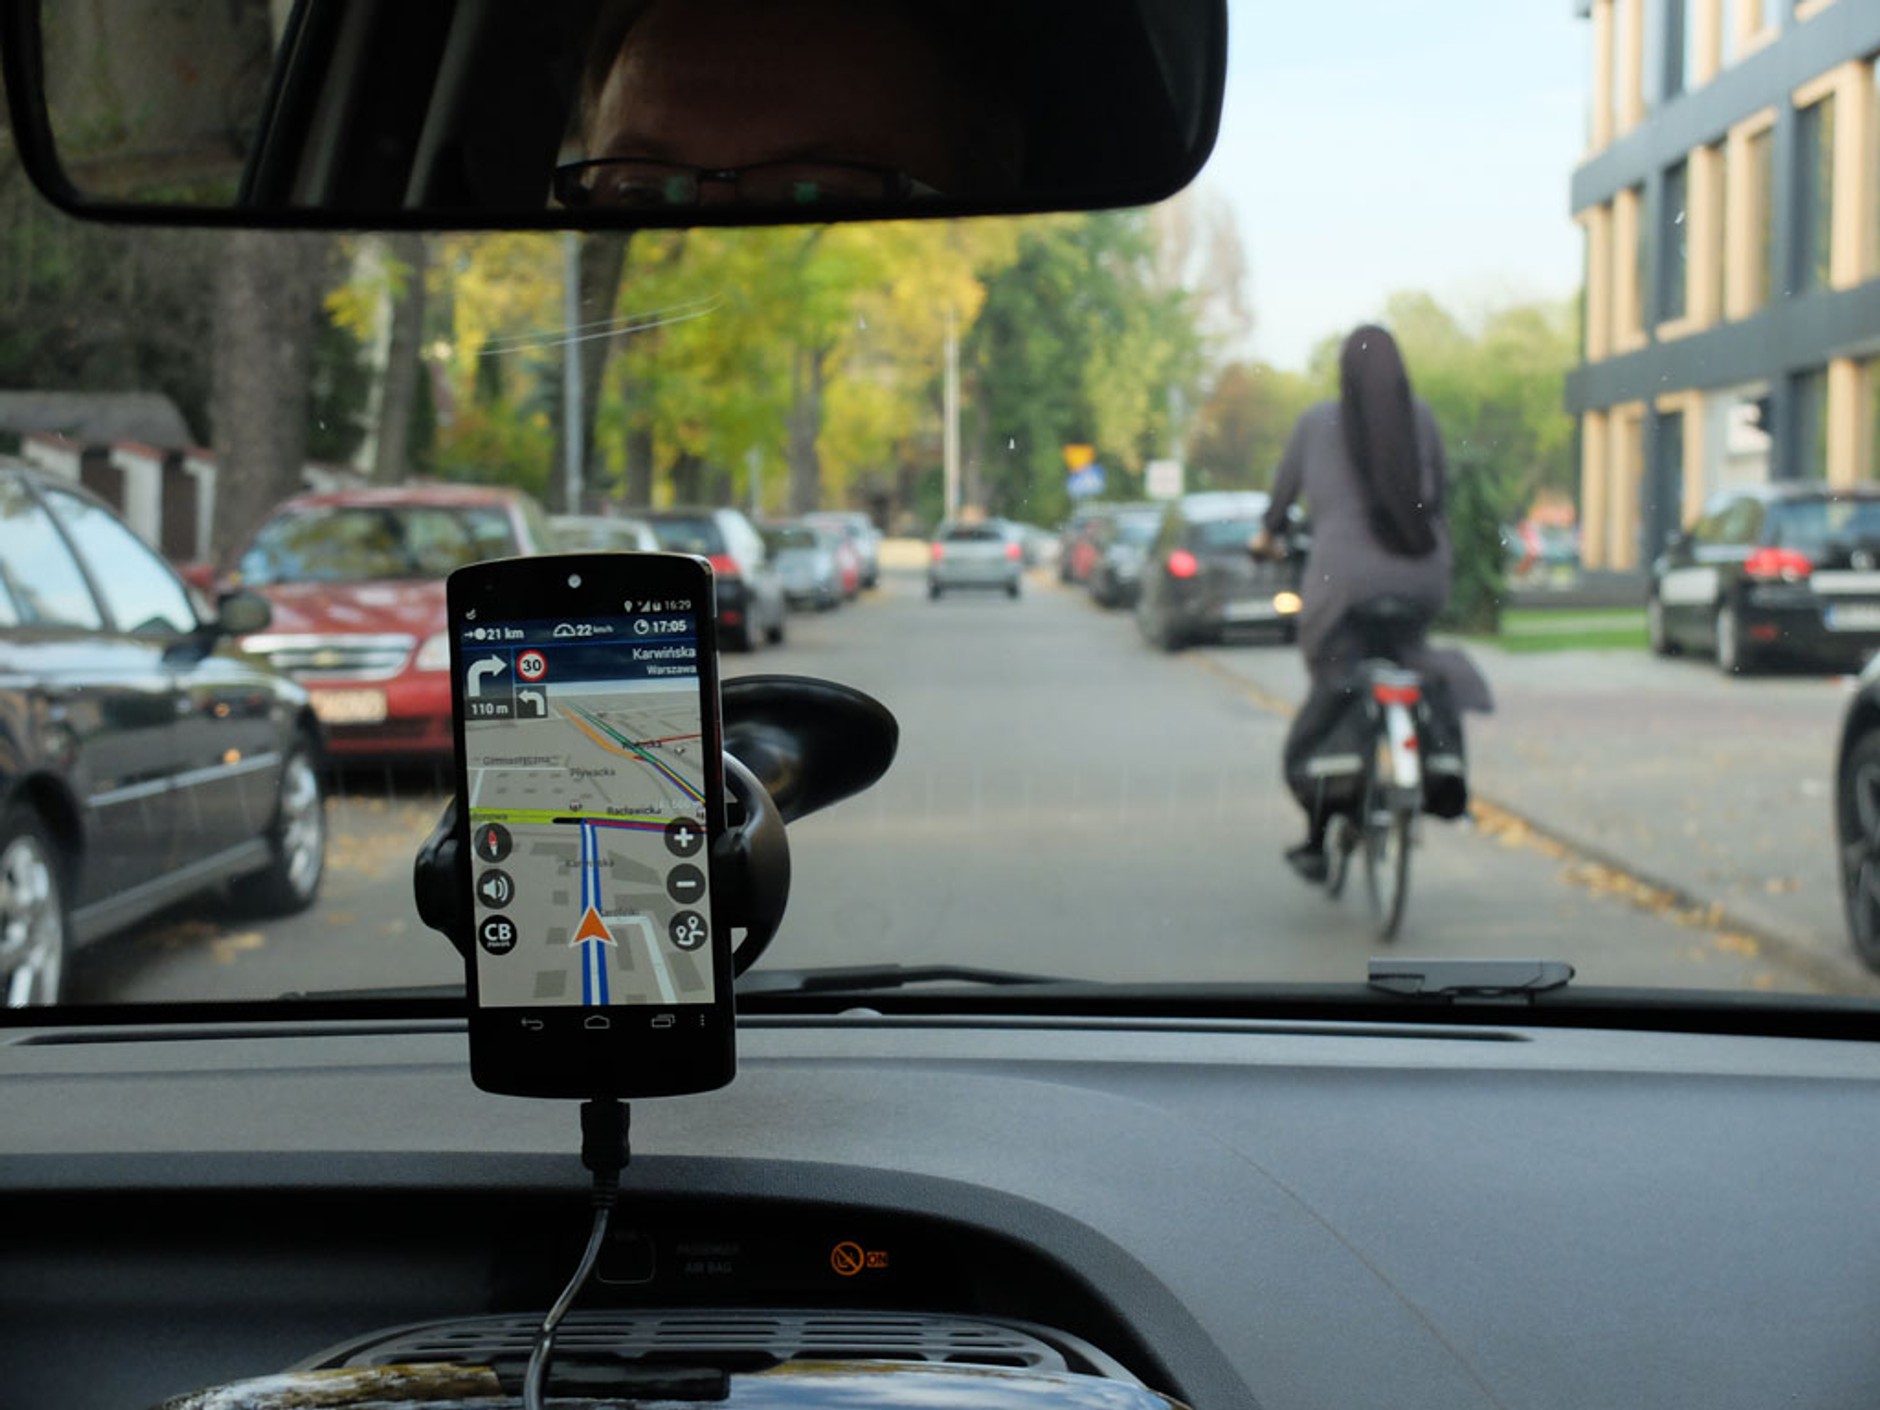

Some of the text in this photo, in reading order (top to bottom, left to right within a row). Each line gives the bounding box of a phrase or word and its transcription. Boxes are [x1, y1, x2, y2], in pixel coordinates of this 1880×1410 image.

[664, 600, 691, 611] 16:29
[576, 624, 592, 636] 22
[652, 619, 687, 633] 17:05
[487, 627, 524, 640] 21 km
[632, 646, 697, 660] Karwińska
[522, 658, 542, 673] 30
[646, 664, 697, 675] Warszawa
[471, 703, 509, 715] 110 m
[484, 923, 512, 941] CB
